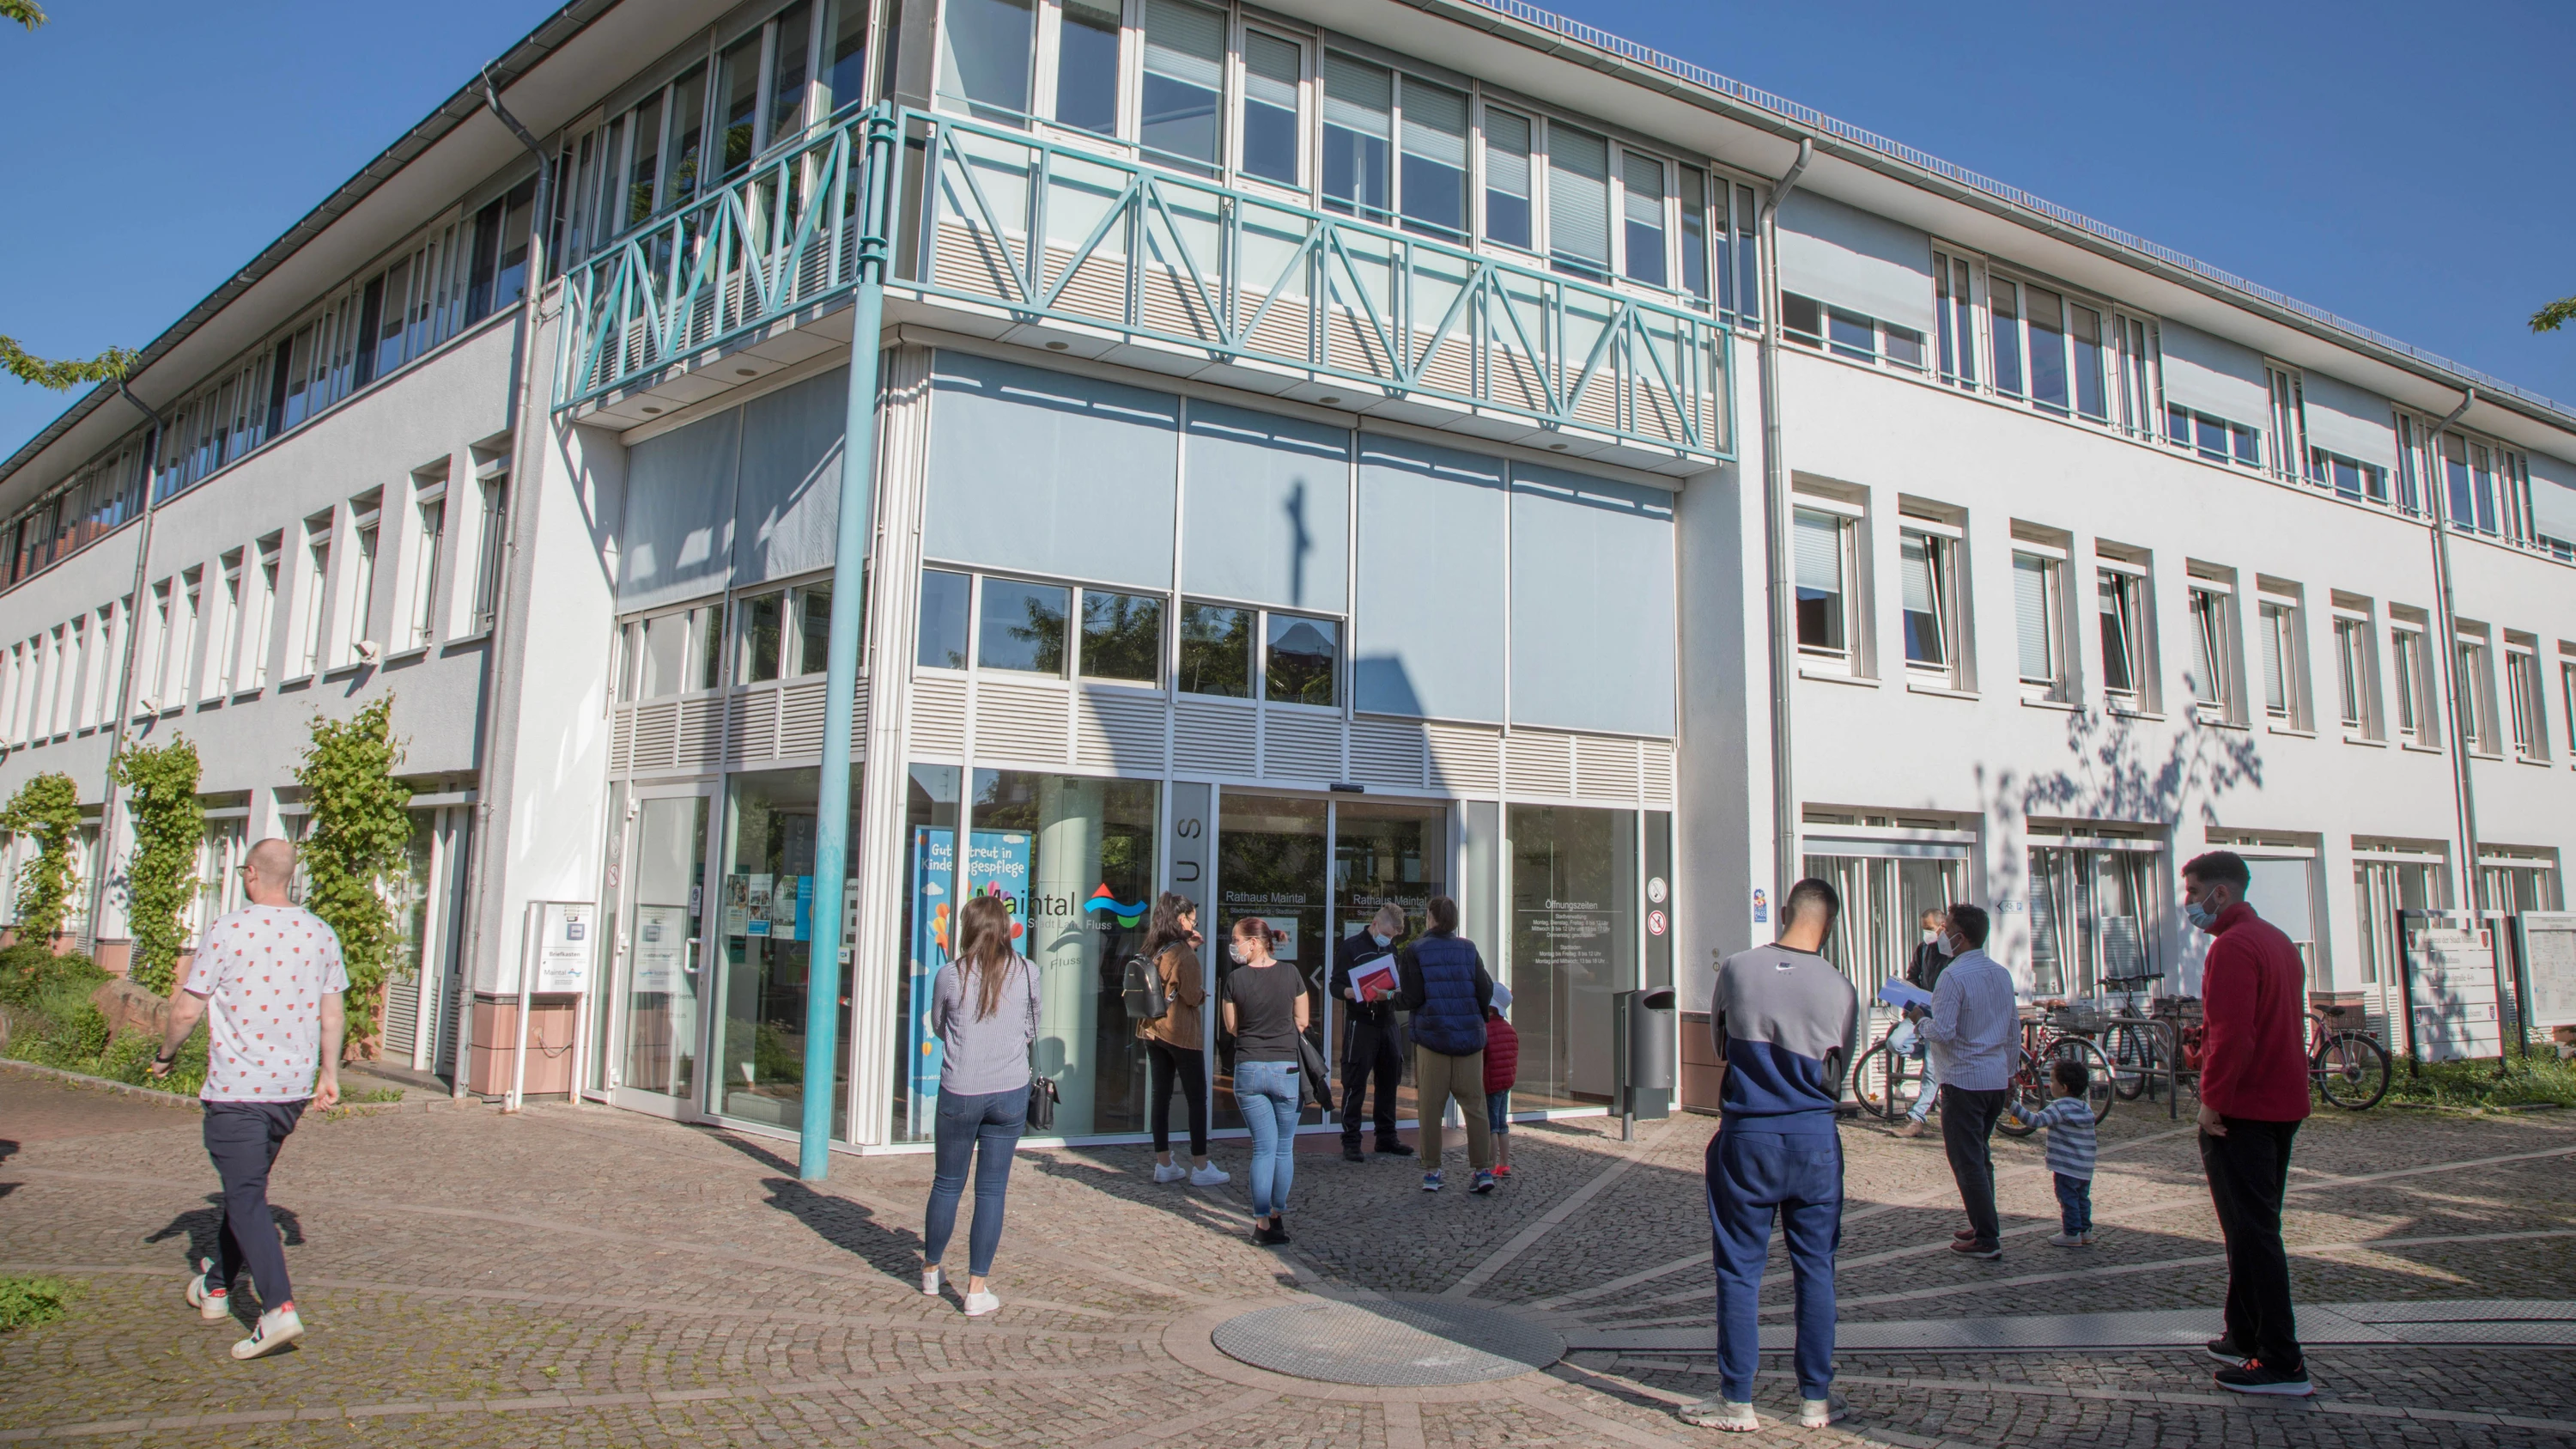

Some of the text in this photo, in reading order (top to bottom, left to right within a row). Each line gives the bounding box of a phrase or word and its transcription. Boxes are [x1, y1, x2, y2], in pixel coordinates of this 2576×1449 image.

[932, 843, 951, 856] Gut
[1001, 848, 1012, 858] in
[1226, 891, 1306, 904] Rathaus Maintal
[1353, 894, 1427, 906] Rathaus Maintal
[1546, 898, 1598, 910] Öffnungszeiten
[1028, 917, 1054, 929] Stadt
[1085, 919, 1112, 930] Fluss
